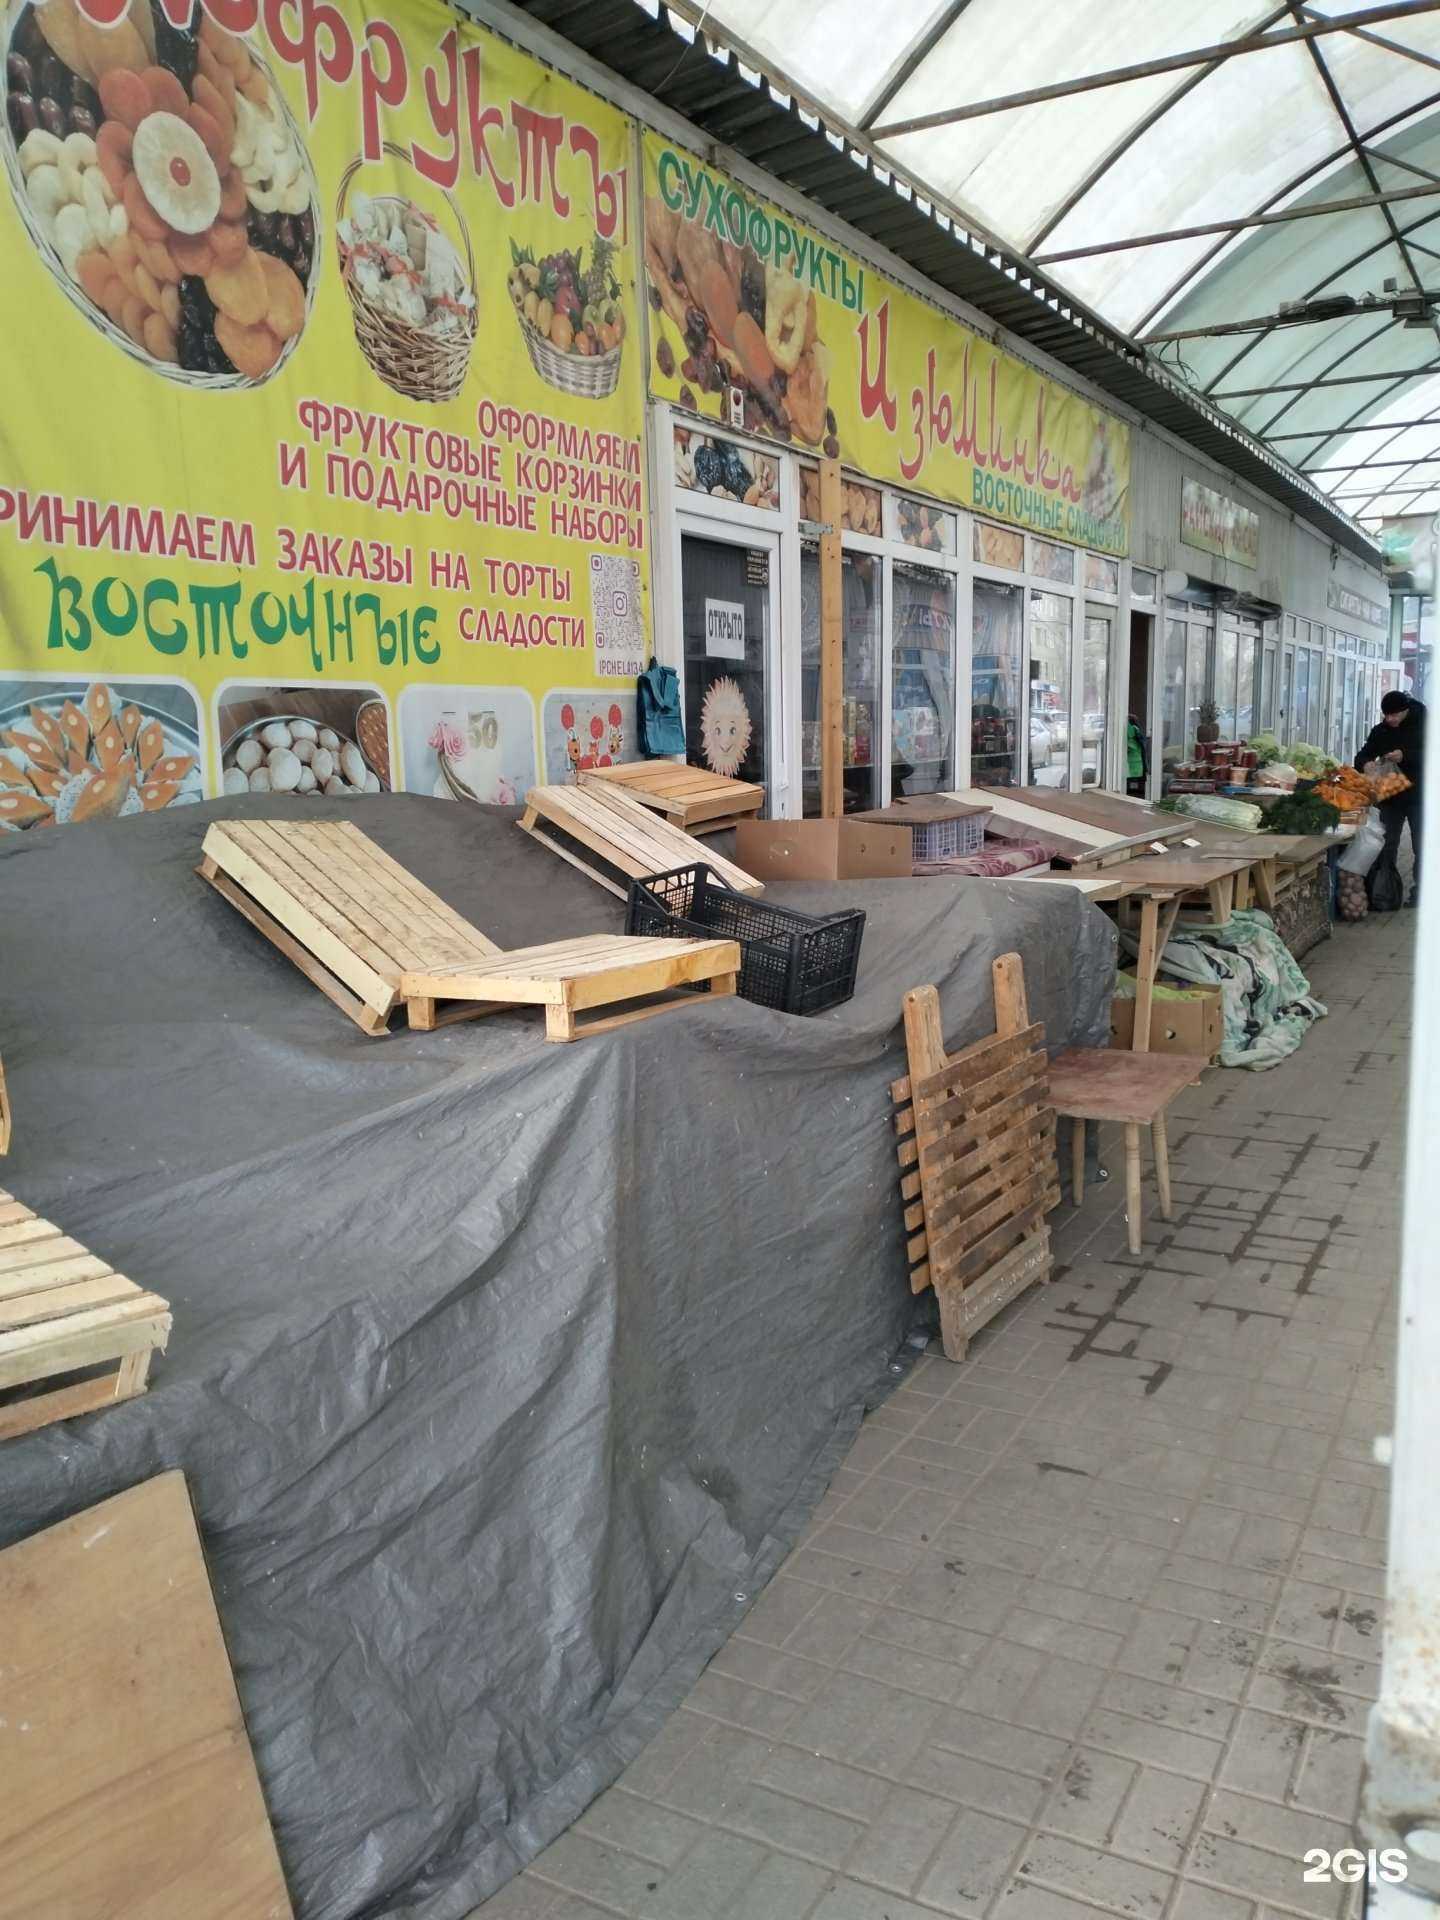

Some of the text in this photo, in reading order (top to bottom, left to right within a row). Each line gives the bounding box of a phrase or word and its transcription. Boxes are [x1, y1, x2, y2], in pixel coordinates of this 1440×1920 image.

[658, 151, 864, 314] СУХОФРУКТЫ
[299, 401, 642, 511] ФРУКТОВЫЕ КОРЗИНКИ
[478, 400, 641, 475] ОФОРМЛЯЕМ
[279, 443, 643, 549] И ПОДАРОЧНЫЕ НАБОРЫ
[973, 467, 1063, 532] ВОСТОЧНЫЕ
[277, 528, 412, 584] ЗАКАЗЫ
[431, 551, 471, 591] НА
[484, 558, 571, 602] ТОРТЫ
[459, 607, 586, 648] СЛАДОСТИ
[708, 609, 743, 641] ОТКРЫТО
